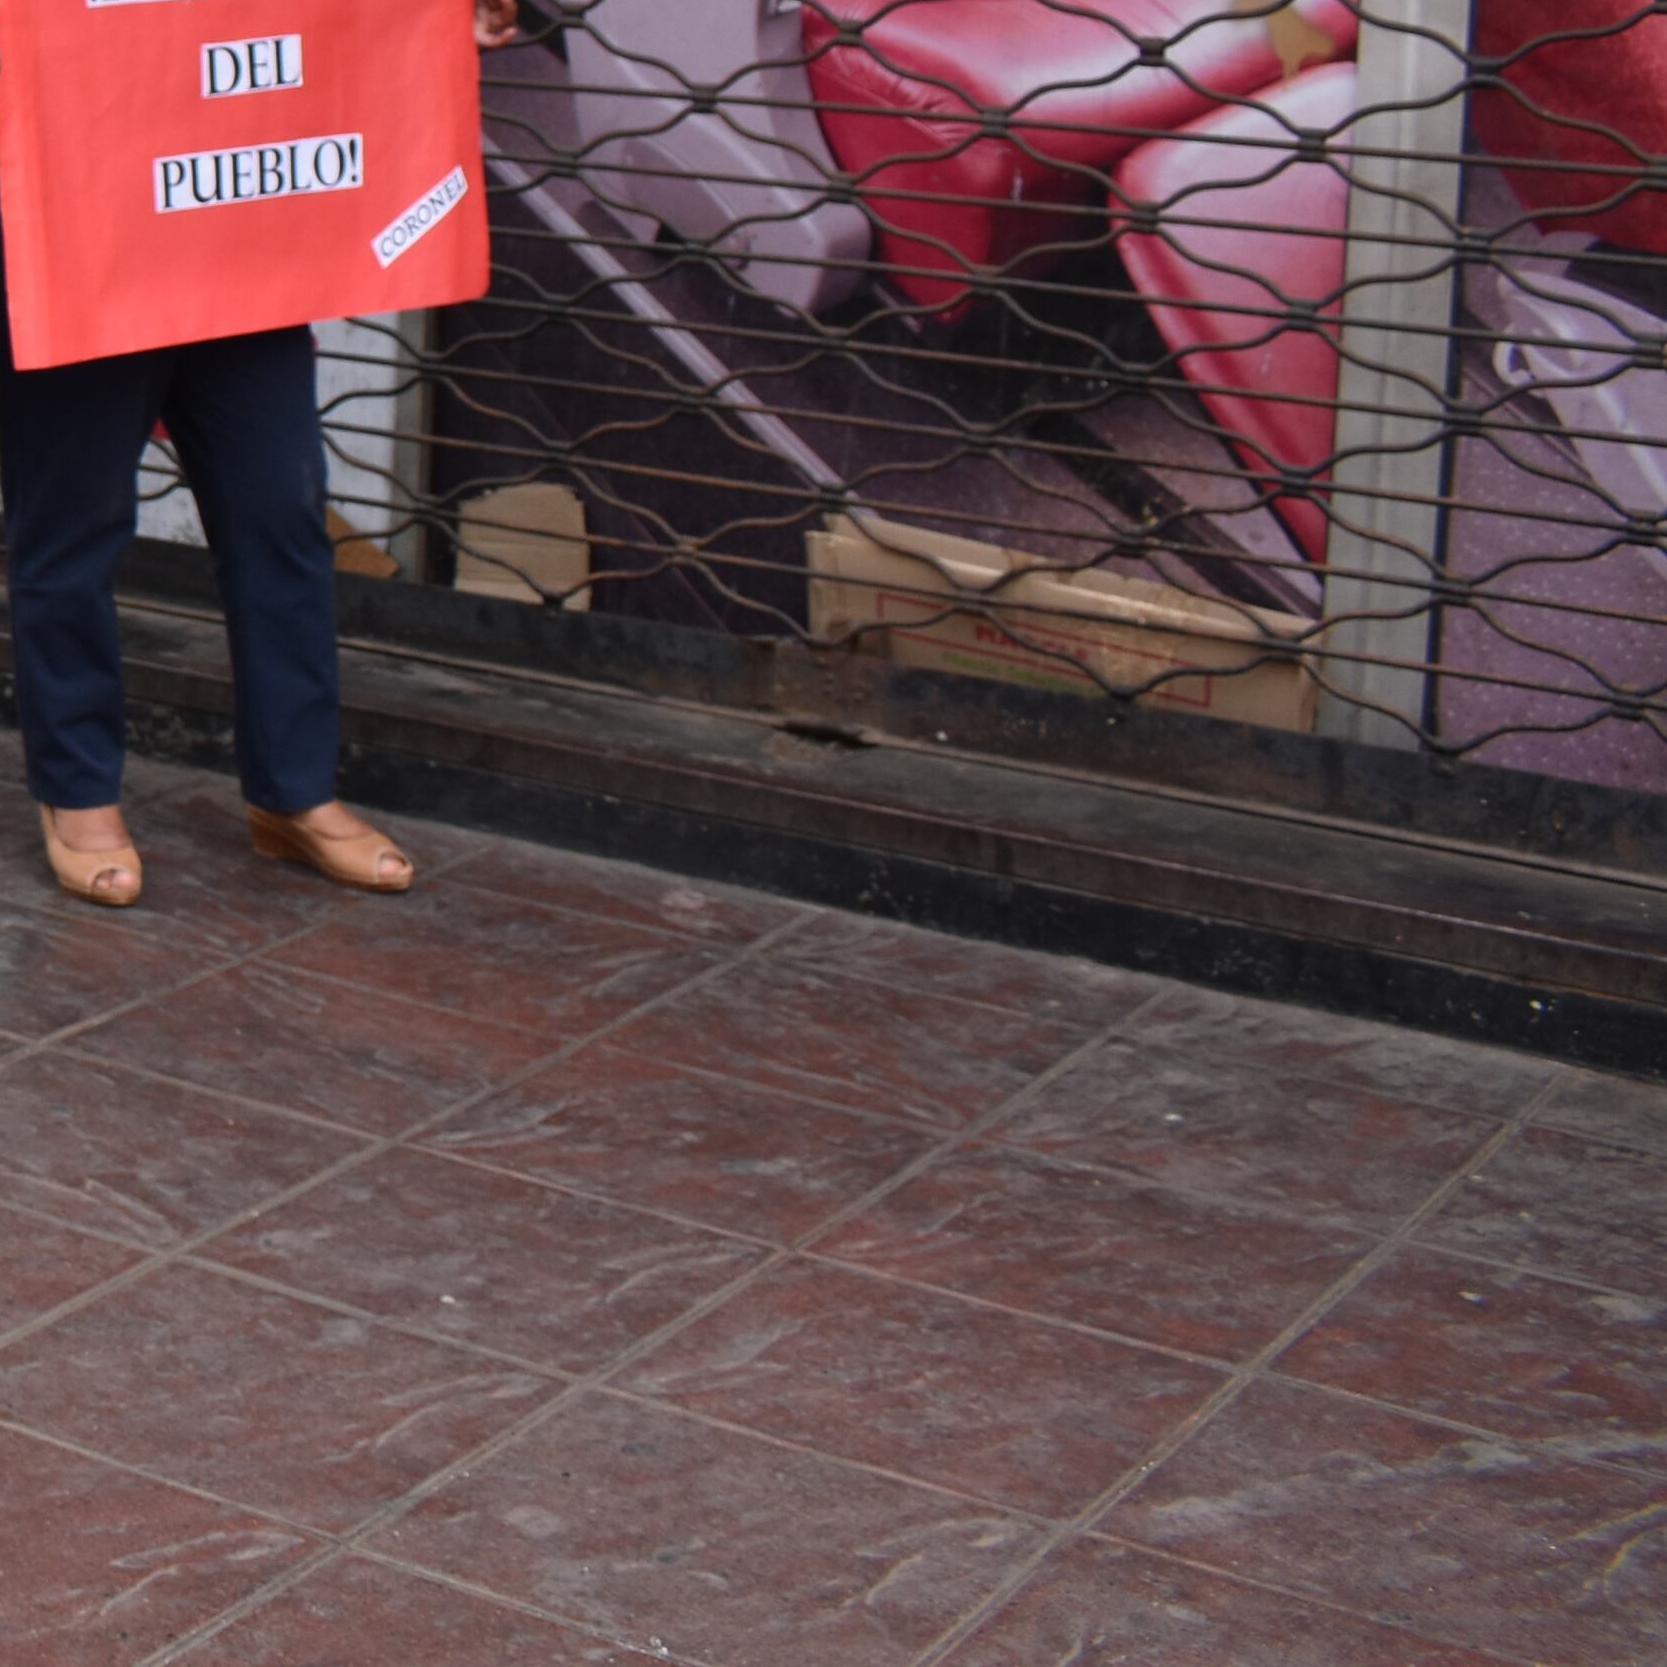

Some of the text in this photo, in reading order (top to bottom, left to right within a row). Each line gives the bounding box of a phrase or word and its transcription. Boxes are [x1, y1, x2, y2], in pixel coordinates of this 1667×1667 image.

[206, 38, 302, 97] DEL
[161, 137, 359, 209] PUEBLO!
[379, 173, 464, 258] CORONEL
